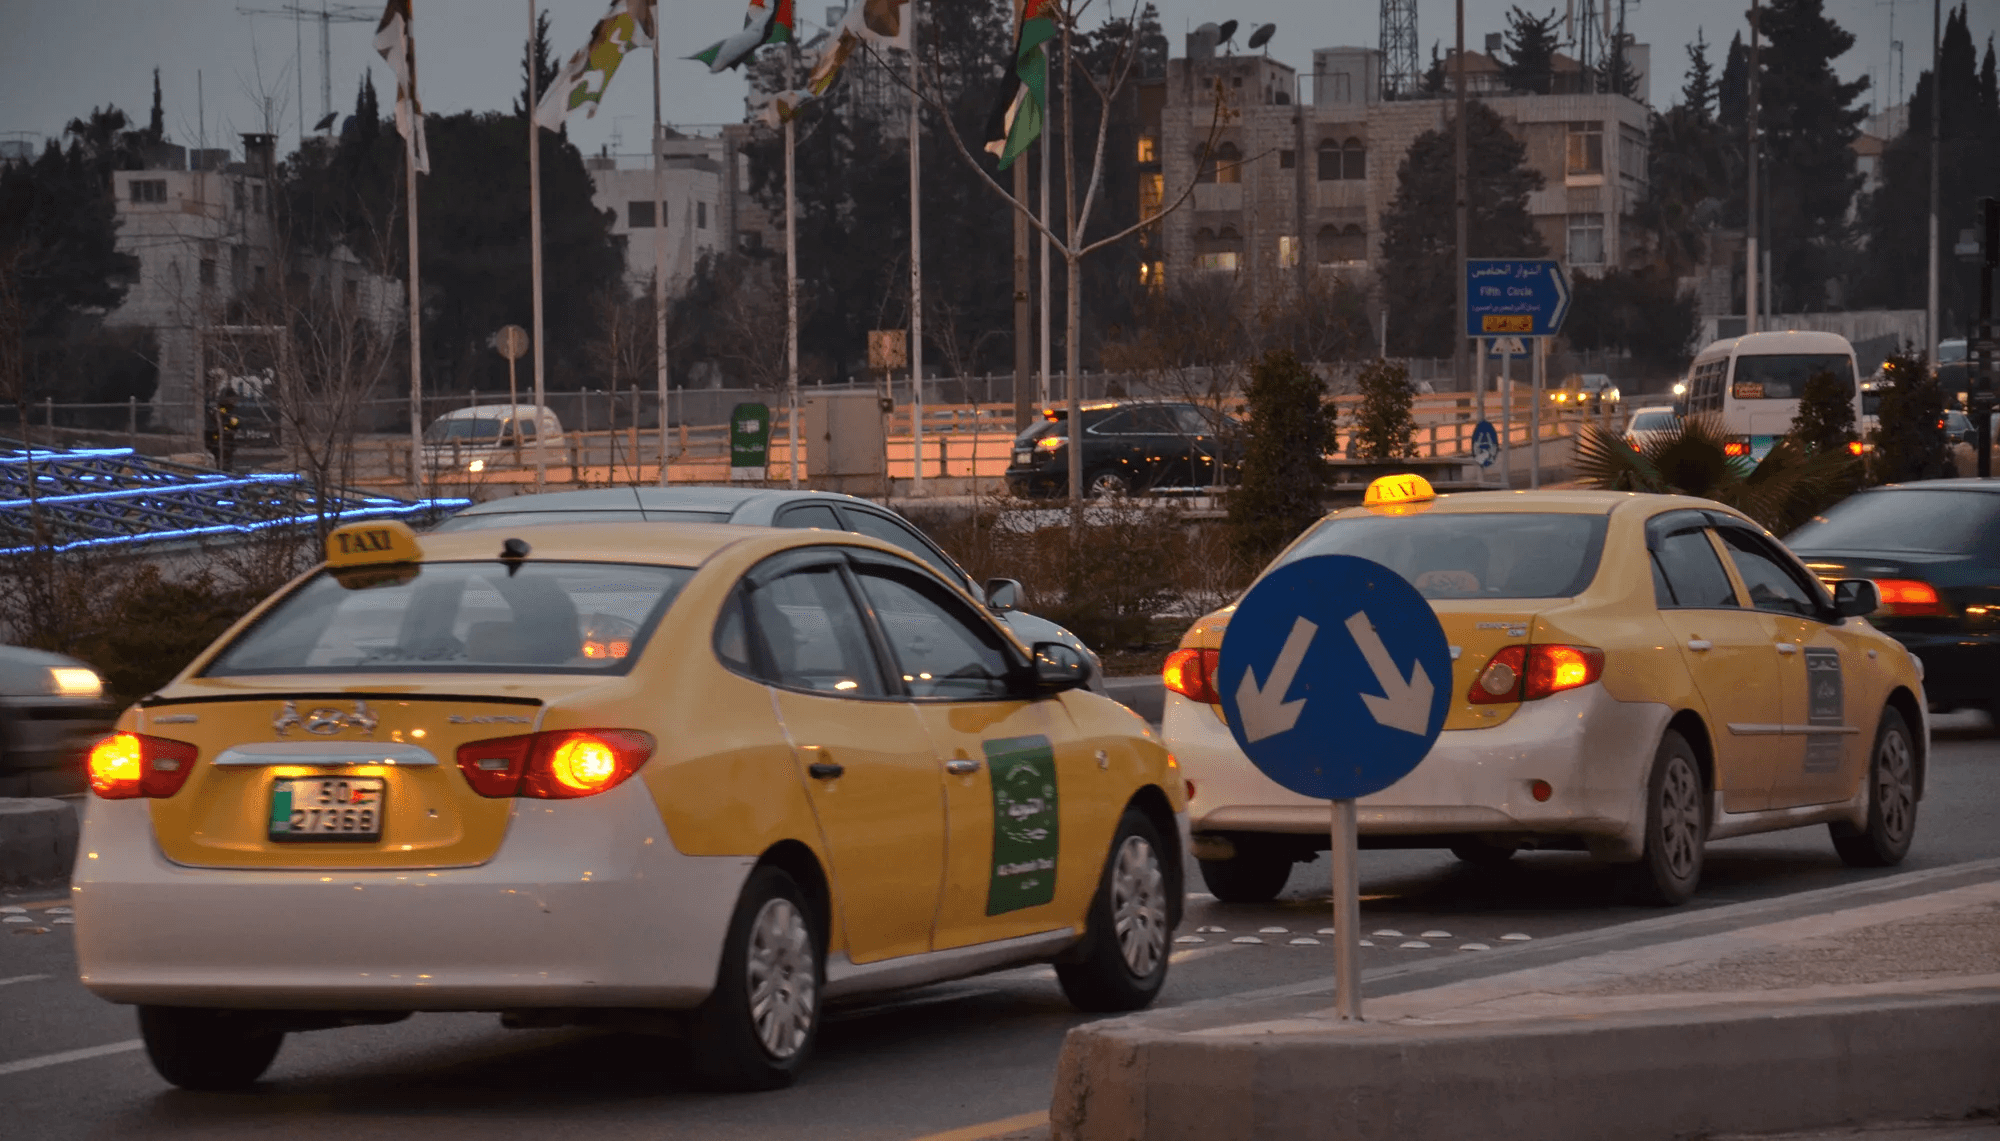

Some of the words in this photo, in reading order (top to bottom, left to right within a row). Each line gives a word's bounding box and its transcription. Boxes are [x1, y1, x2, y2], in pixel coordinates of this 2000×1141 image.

[1480, 286, 1501, 296] Fifth
[1507, 286, 1533, 296] Circle
[1371, 481, 1416, 499] TAXI
[336, 530, 393, 554] TAXI
[320, 781, 349, 805] 50
